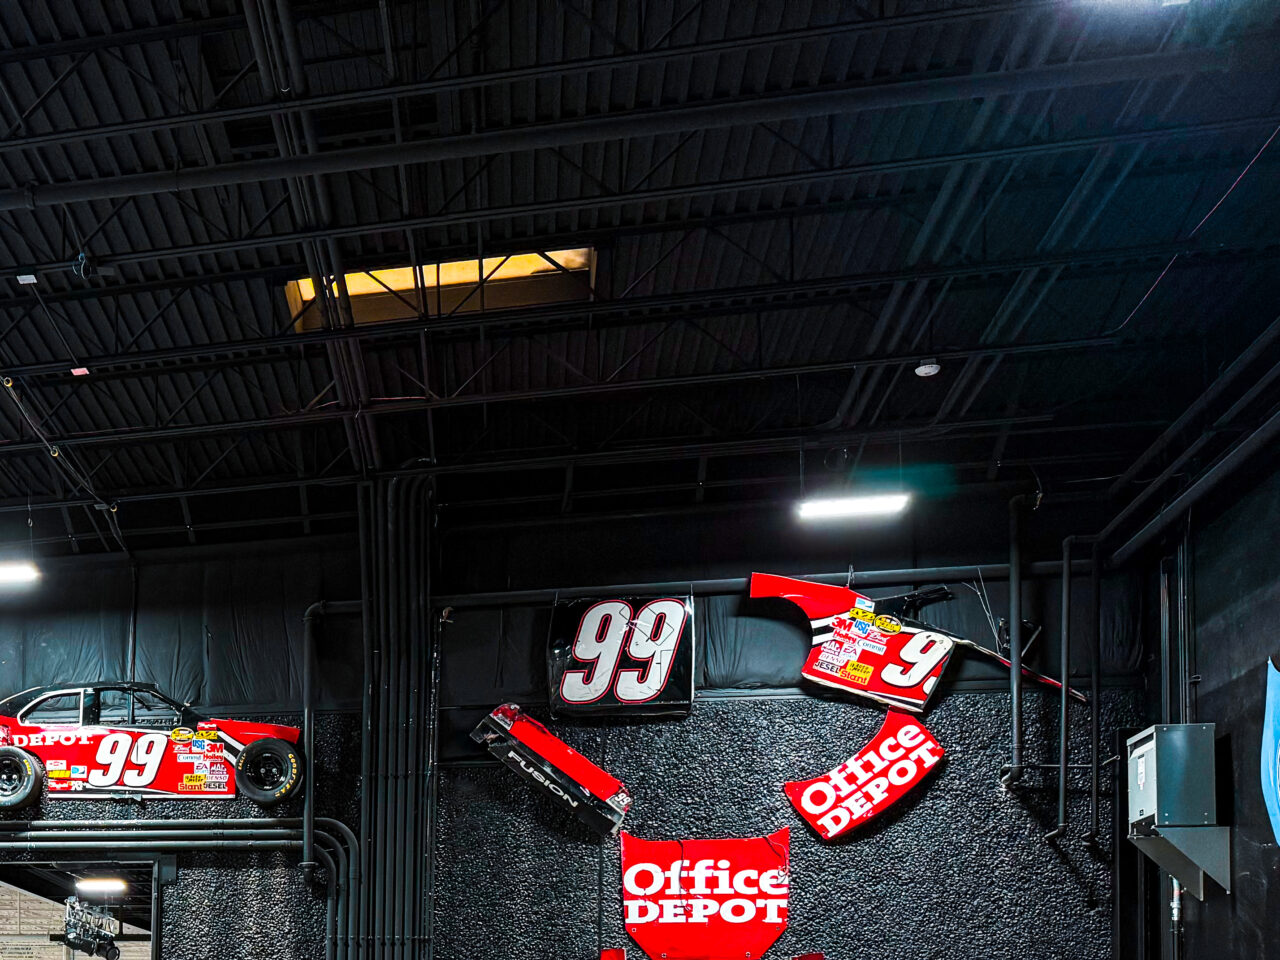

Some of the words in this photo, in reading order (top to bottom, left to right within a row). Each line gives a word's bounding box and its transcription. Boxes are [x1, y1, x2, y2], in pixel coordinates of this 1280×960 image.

[832, 617, 854, 632] 3M
[854, 620, 870, 634] USG
[560, 598, 689, 704] 99
[815, 661, 841, 673] JESEL
[840, 669, 868, 684] Stant
[192, 740, 205, 750] USG
[206, 743, 224, 753] 3M
[88, 733, 168, 787] 99
[801, 725, 925, 815] Office
[508, 751, 579, 808] FUSION
[817, 740, 940, 838] DEPOT
[614, 791, 632, 805] 99
[624, 860, 789, 895] Office
[624, 899, 788, 924] DEPOT
